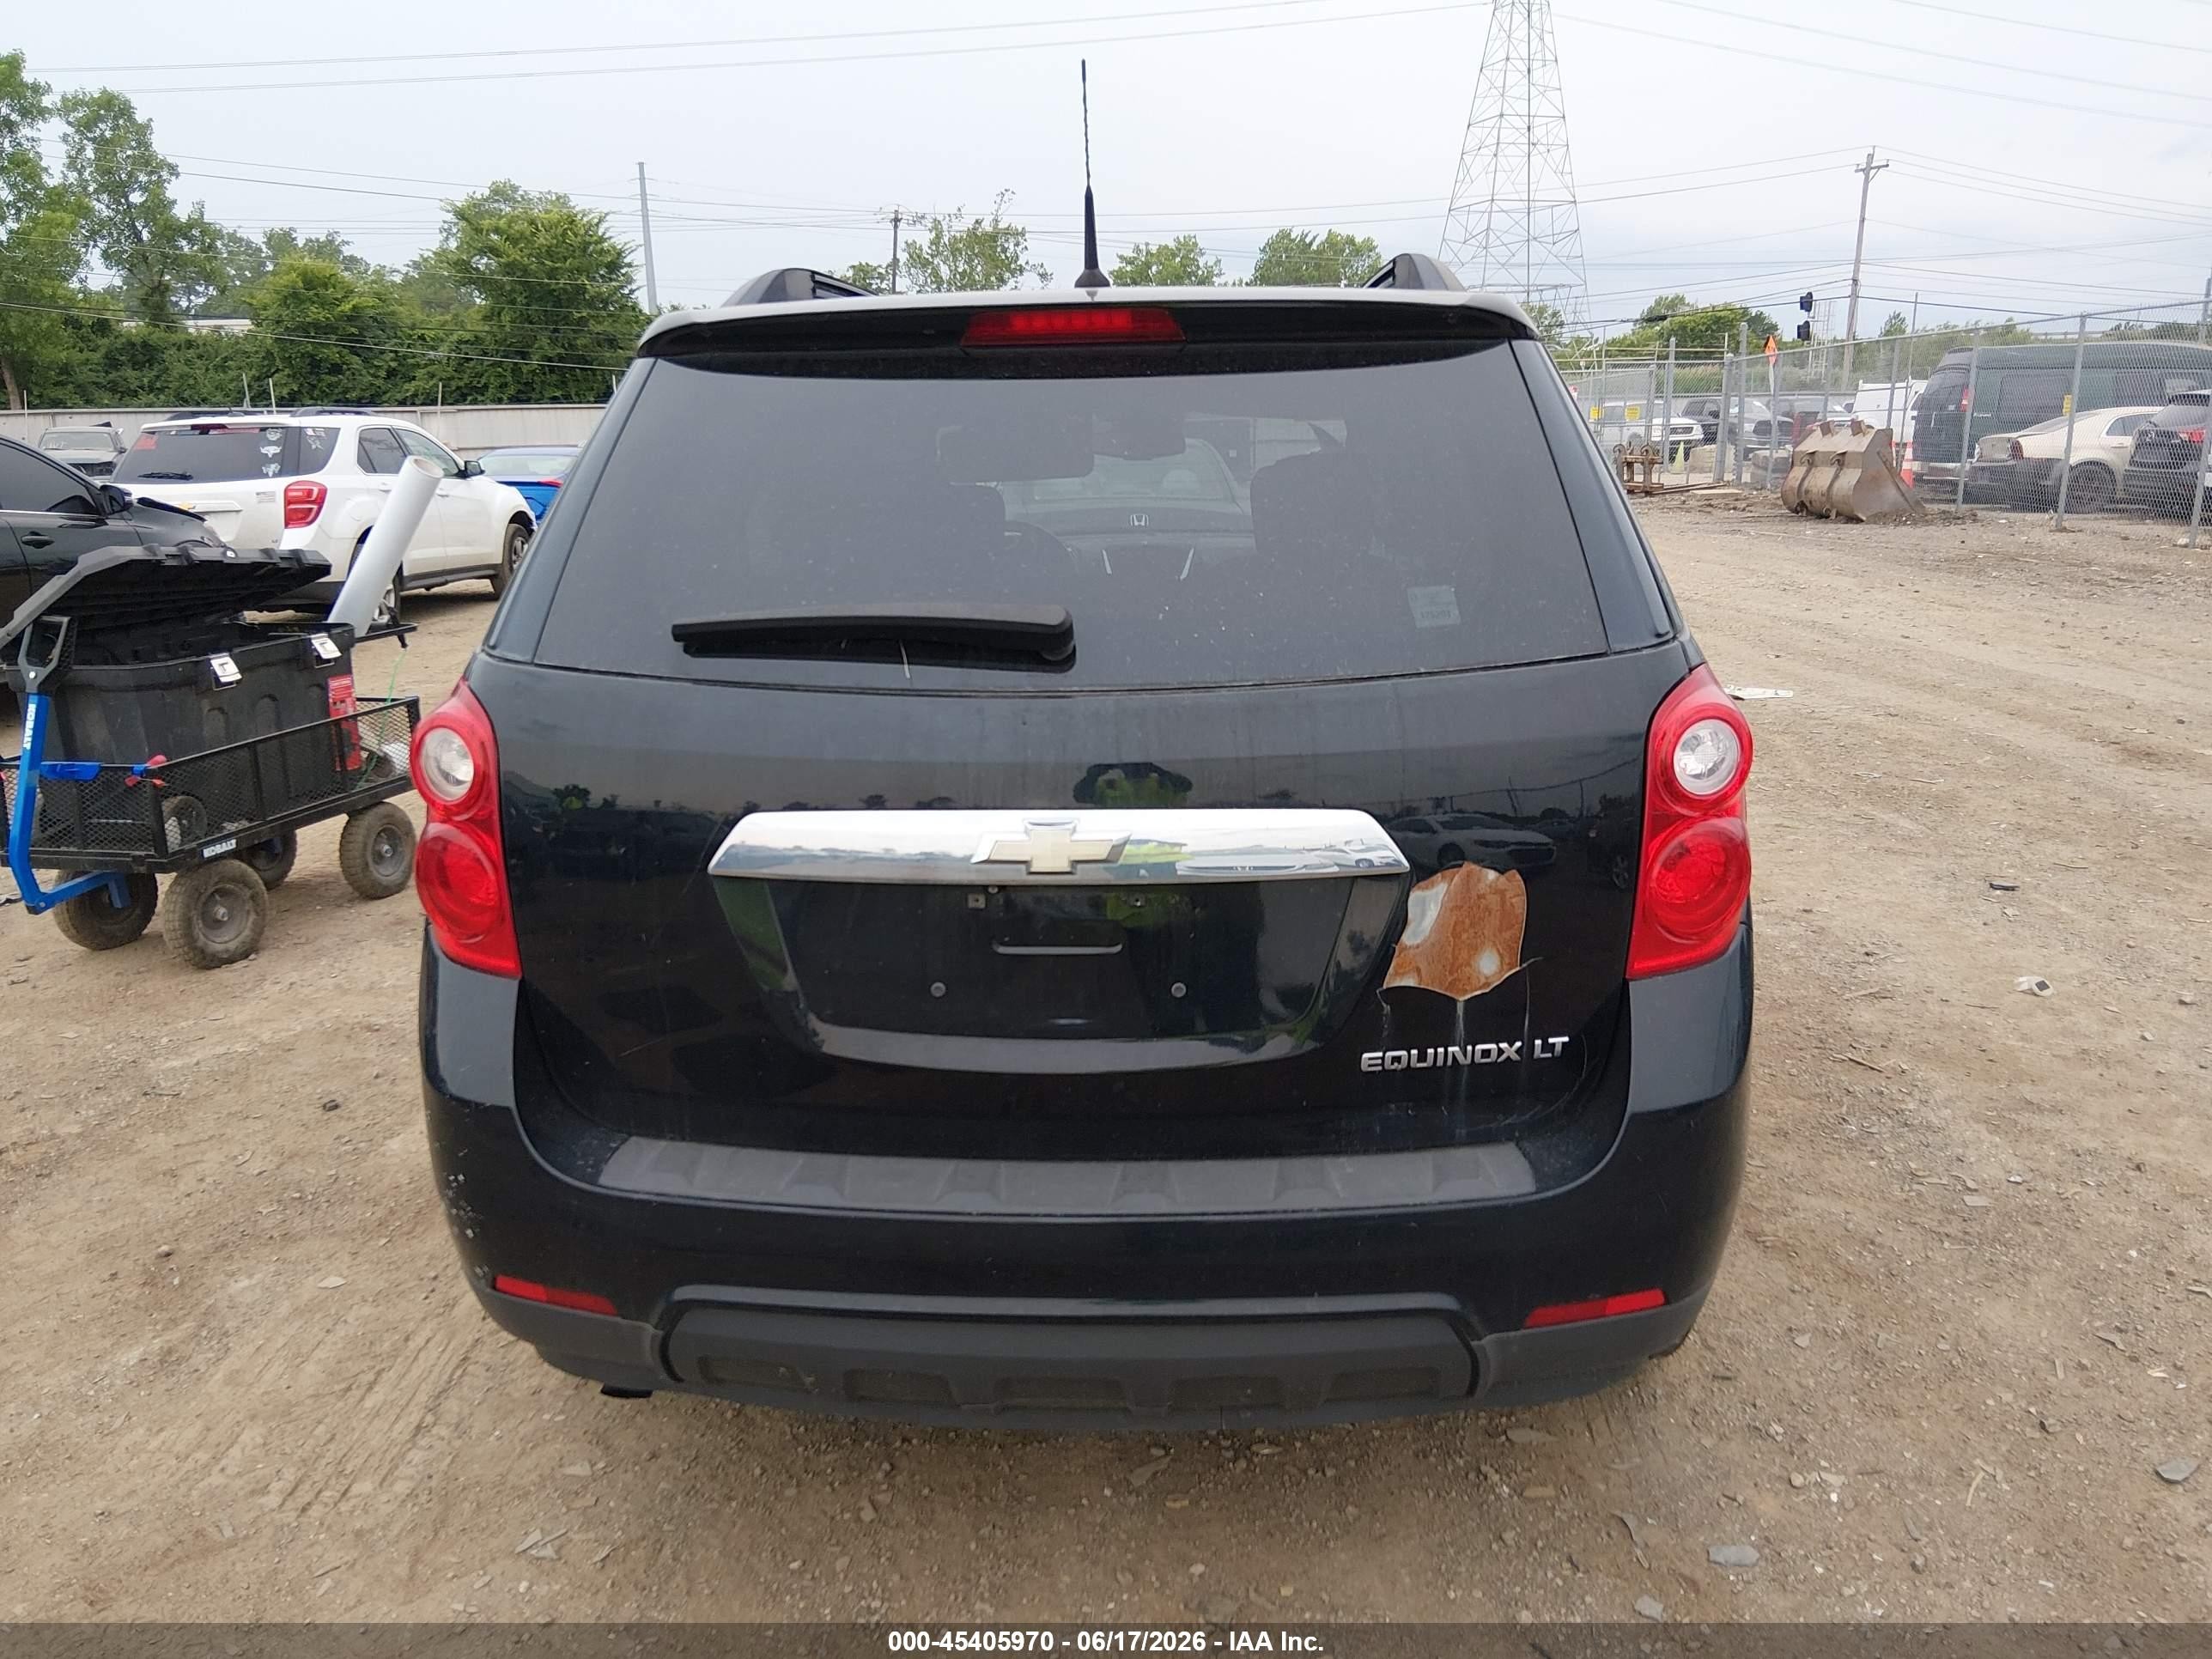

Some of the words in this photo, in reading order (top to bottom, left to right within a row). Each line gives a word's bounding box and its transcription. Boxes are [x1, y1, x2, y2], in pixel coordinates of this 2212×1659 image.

[22, 703, 37, 750] KOBALT
[1360, 1040, 1522, 1072] EQUINOX
[1534, 1036, 1570, 1059] LT
